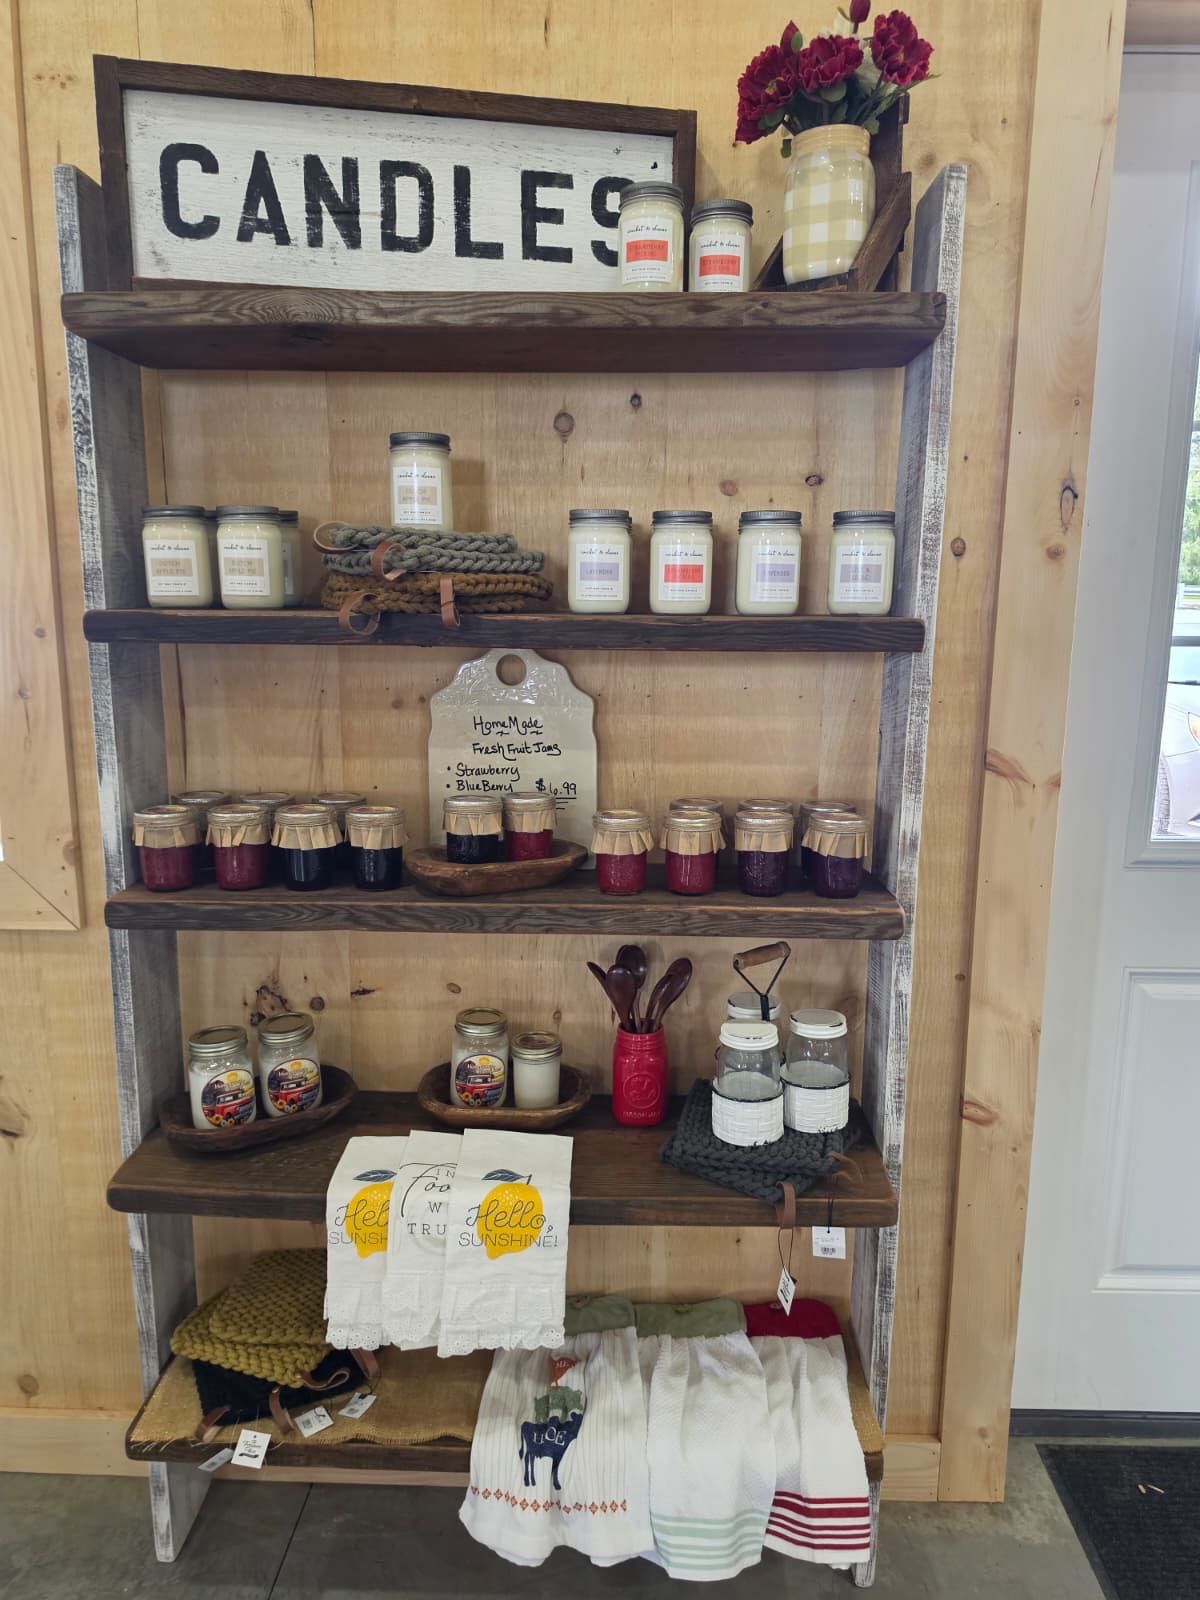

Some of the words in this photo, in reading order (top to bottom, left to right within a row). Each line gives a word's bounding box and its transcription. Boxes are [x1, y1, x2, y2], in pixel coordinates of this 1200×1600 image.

[471, 742, 517, 761] Fresh
[507, 740, 532, 755] Fruit
[532, 742, 562, 757] Jams
[455, 762, 521, 782] Strawberry
[399, 1162, 458, 1218] Foo
[334, 1198, 390, 1231] Hel
[428, 1201, 442, 1214] W
[329, 1231, 388, 1245] SUNSH
[407, 1222, 447, 1236] TRU
[458, 1231, 558, 1248] SUNSHINE!
